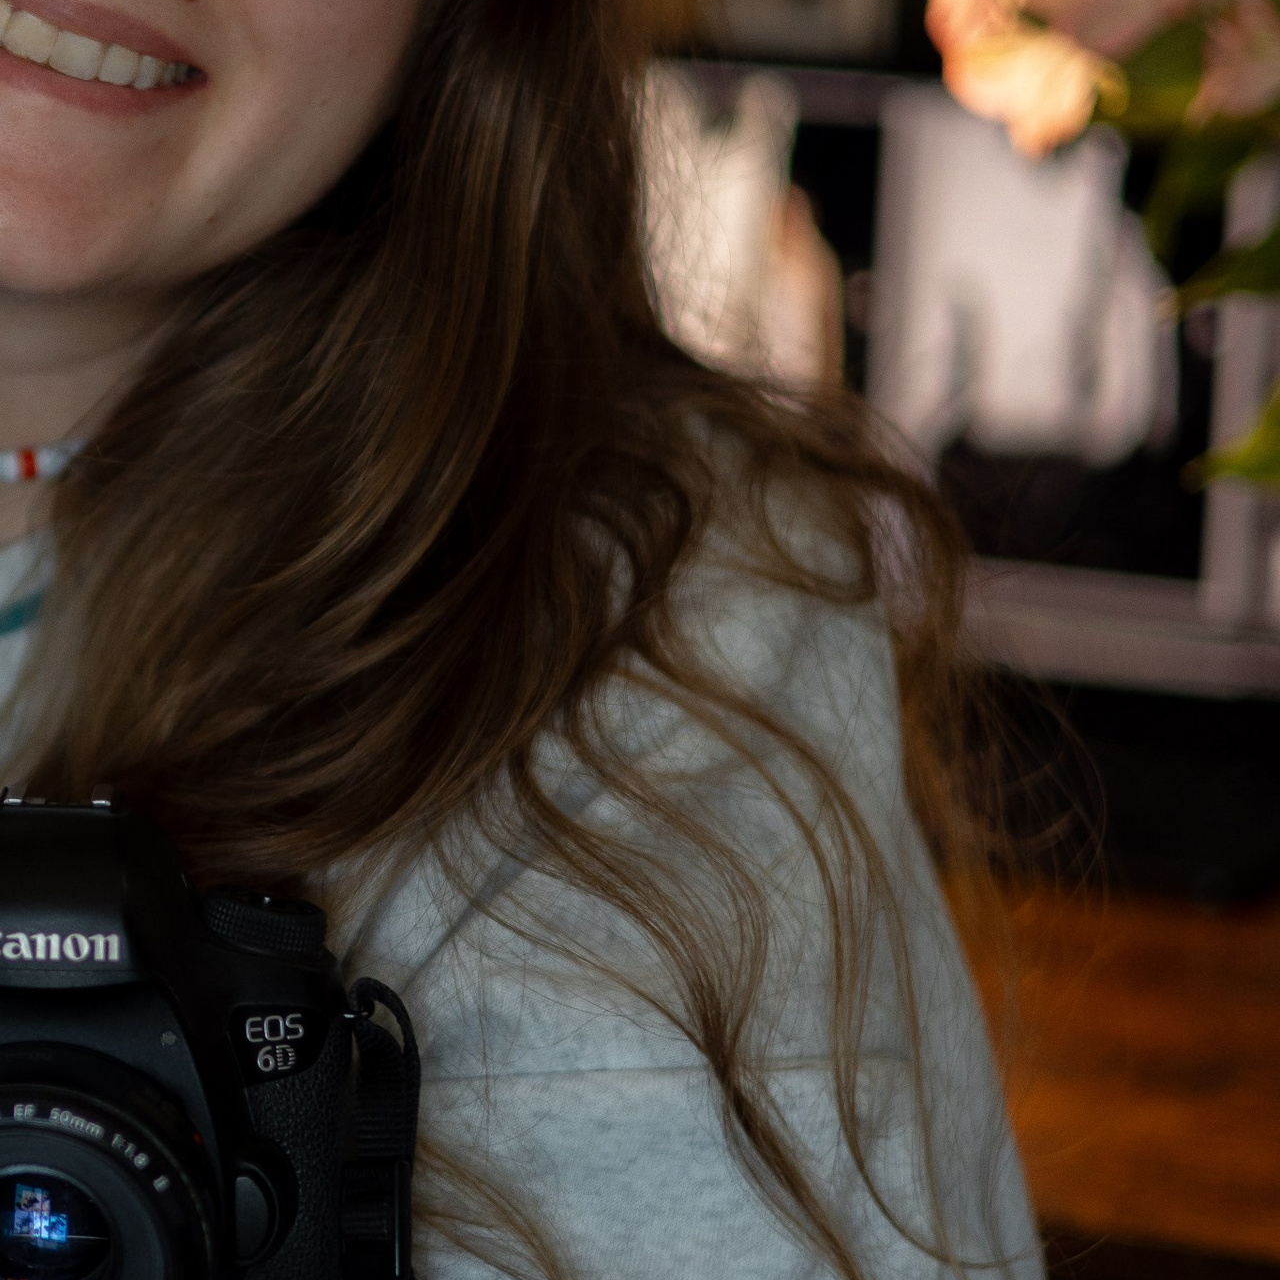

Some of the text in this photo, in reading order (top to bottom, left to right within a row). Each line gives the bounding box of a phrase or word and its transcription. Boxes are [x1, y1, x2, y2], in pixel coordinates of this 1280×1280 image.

[245, 1012, 305, 1044] EOS
[256, 1043, 297, 1073] 6D
[13, 1103, 37, 1122] EF
[49, 1107, 105, 1140] 50mm
